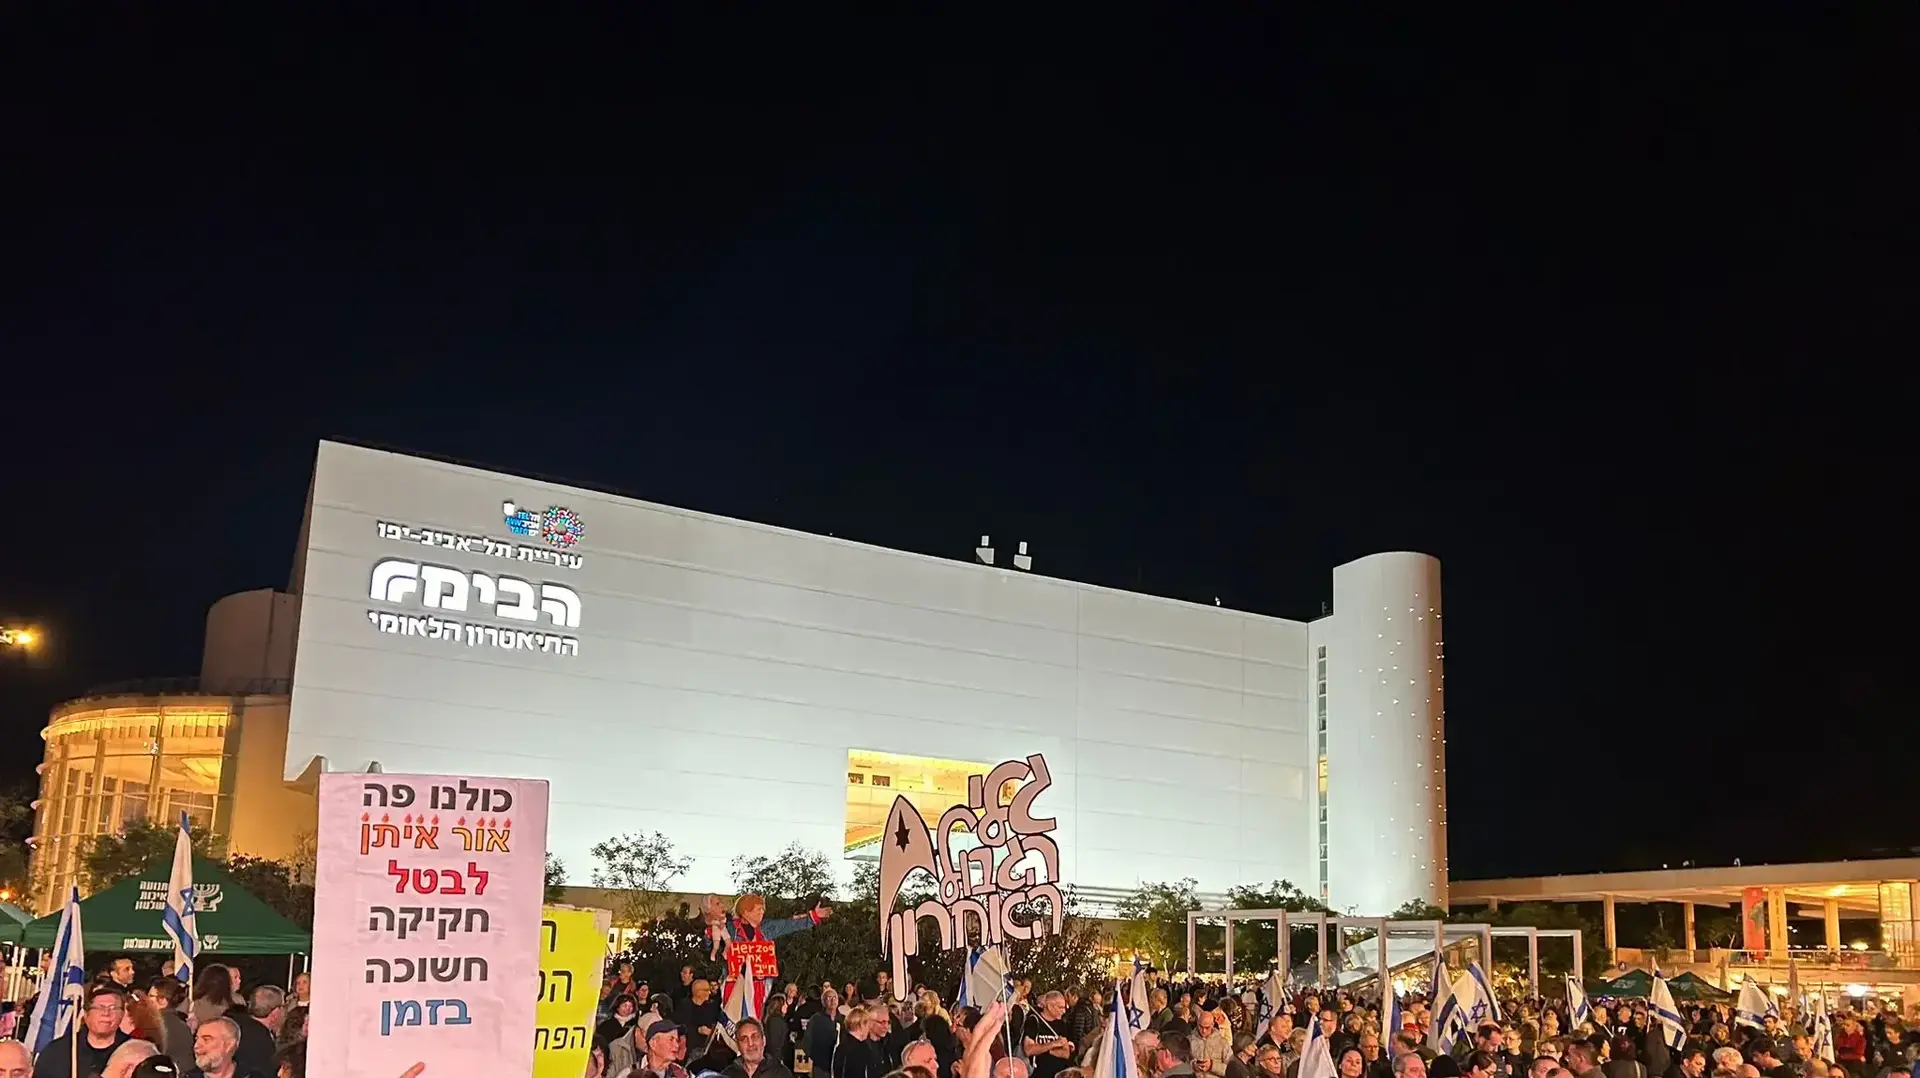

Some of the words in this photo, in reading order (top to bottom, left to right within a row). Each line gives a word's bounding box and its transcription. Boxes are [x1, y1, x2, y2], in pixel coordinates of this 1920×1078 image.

[517, 546, 584, 570] עיריית
[368, 611, 462, 643] הלאומי
[465, 625, 579, 656] התיאטרון
[363, 783, 416, 808] פה
[430, 779, 513, 813] כולנו
[360, 823, 439, 855] איתן
[452, 827, 511, 852] אור
[140, 881, 169, 891] תנועה
[388, 859, 489, 896] לבטל
[135, 901, 166, 911] שלטון
[140, 891, 168, 901] איכות
[369, 906, 490, 940] חקיקה
[730, 943, 776, 956] Herzog
[365, 957, 489, 983] חשוכה
[381, 999, 472, 1036] בזמן
